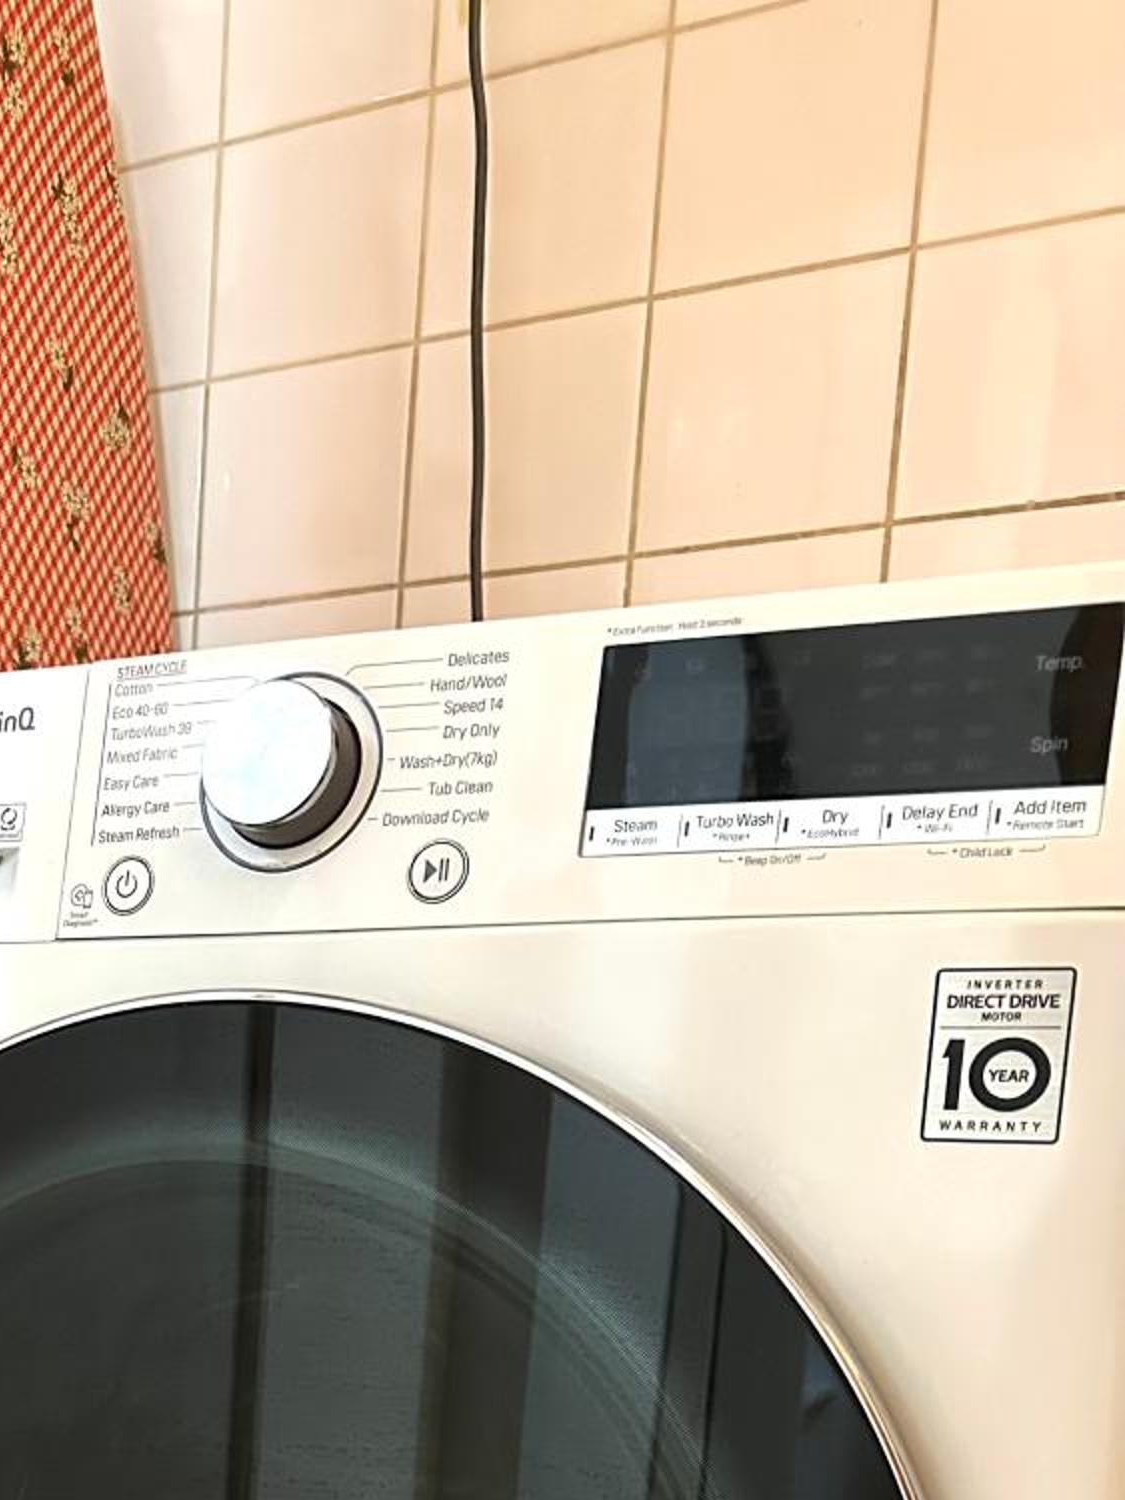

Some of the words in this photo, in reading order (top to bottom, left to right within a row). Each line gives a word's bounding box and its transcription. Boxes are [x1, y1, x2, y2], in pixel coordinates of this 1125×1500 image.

[448, 651, 510, 667] Delicates
[117, 666, 155, 680] STEAM
[155, 659, 188, 676] CYCLE
[115, 683, 154, 698] Cotton
[430, 673, 508, 692] Hand/Wool
[112, 705, 134, 720] Eco
[135, 702, 170, 718] 40-60
[443, 699, 486, 717] Speed
[490, 697, 504, 712] 14
[112, 724, 176, 741] TurboWash
[443, 725, 468, 741] Dry
[470, 722, 500, 740] Only
[1031, 737, 1068, 756] Spin
[106, 750, 141, 765] Mixed
[143, 747, 178, 761] Fabric
[400, 749, 498, 769] Wash+Dry(7kg)
[103, 777, 130, 792] Easy
[132, 775, 160, 790] Care
[429, 781, 453, 796] Tub
[455, 780, 494, 795] Clean
[101, 803, 142, 819] Allergy
[144, 801, 170, 815] Care
[902, 805, 946, 822] Delay
[948, 803, 979, 819] End
[1013, 799, 1048, 815] Add
[1050, 799, 1087, 815] Item
[382, 811, 450, 827] Download
[452, 807, 490, 825] Cycle
[696, 815, 735, 829] Turbo
[737, 811, 775, 827] Wash
[822, 808, 849, 825] Dry
[1056, 819, 1084, 830] Start
[98, 829, 134, 844] Steam
[136, 825, 181, 841] Refresh
[614, 819, 659, 833] Steam
[966, 978, 1044, 990] INVERTER
[946, 993, 1007, 1010] DIRECT
[1008, 993, 1062, 1010] DRIVE
[980, 1011, 1023, 1023] MOTOR
[941, 1036, 1052, 1113] 10
[987, 1068, 1030, 1084] YEAR
[939, 1119, 1043, 1133] WARRANTY
